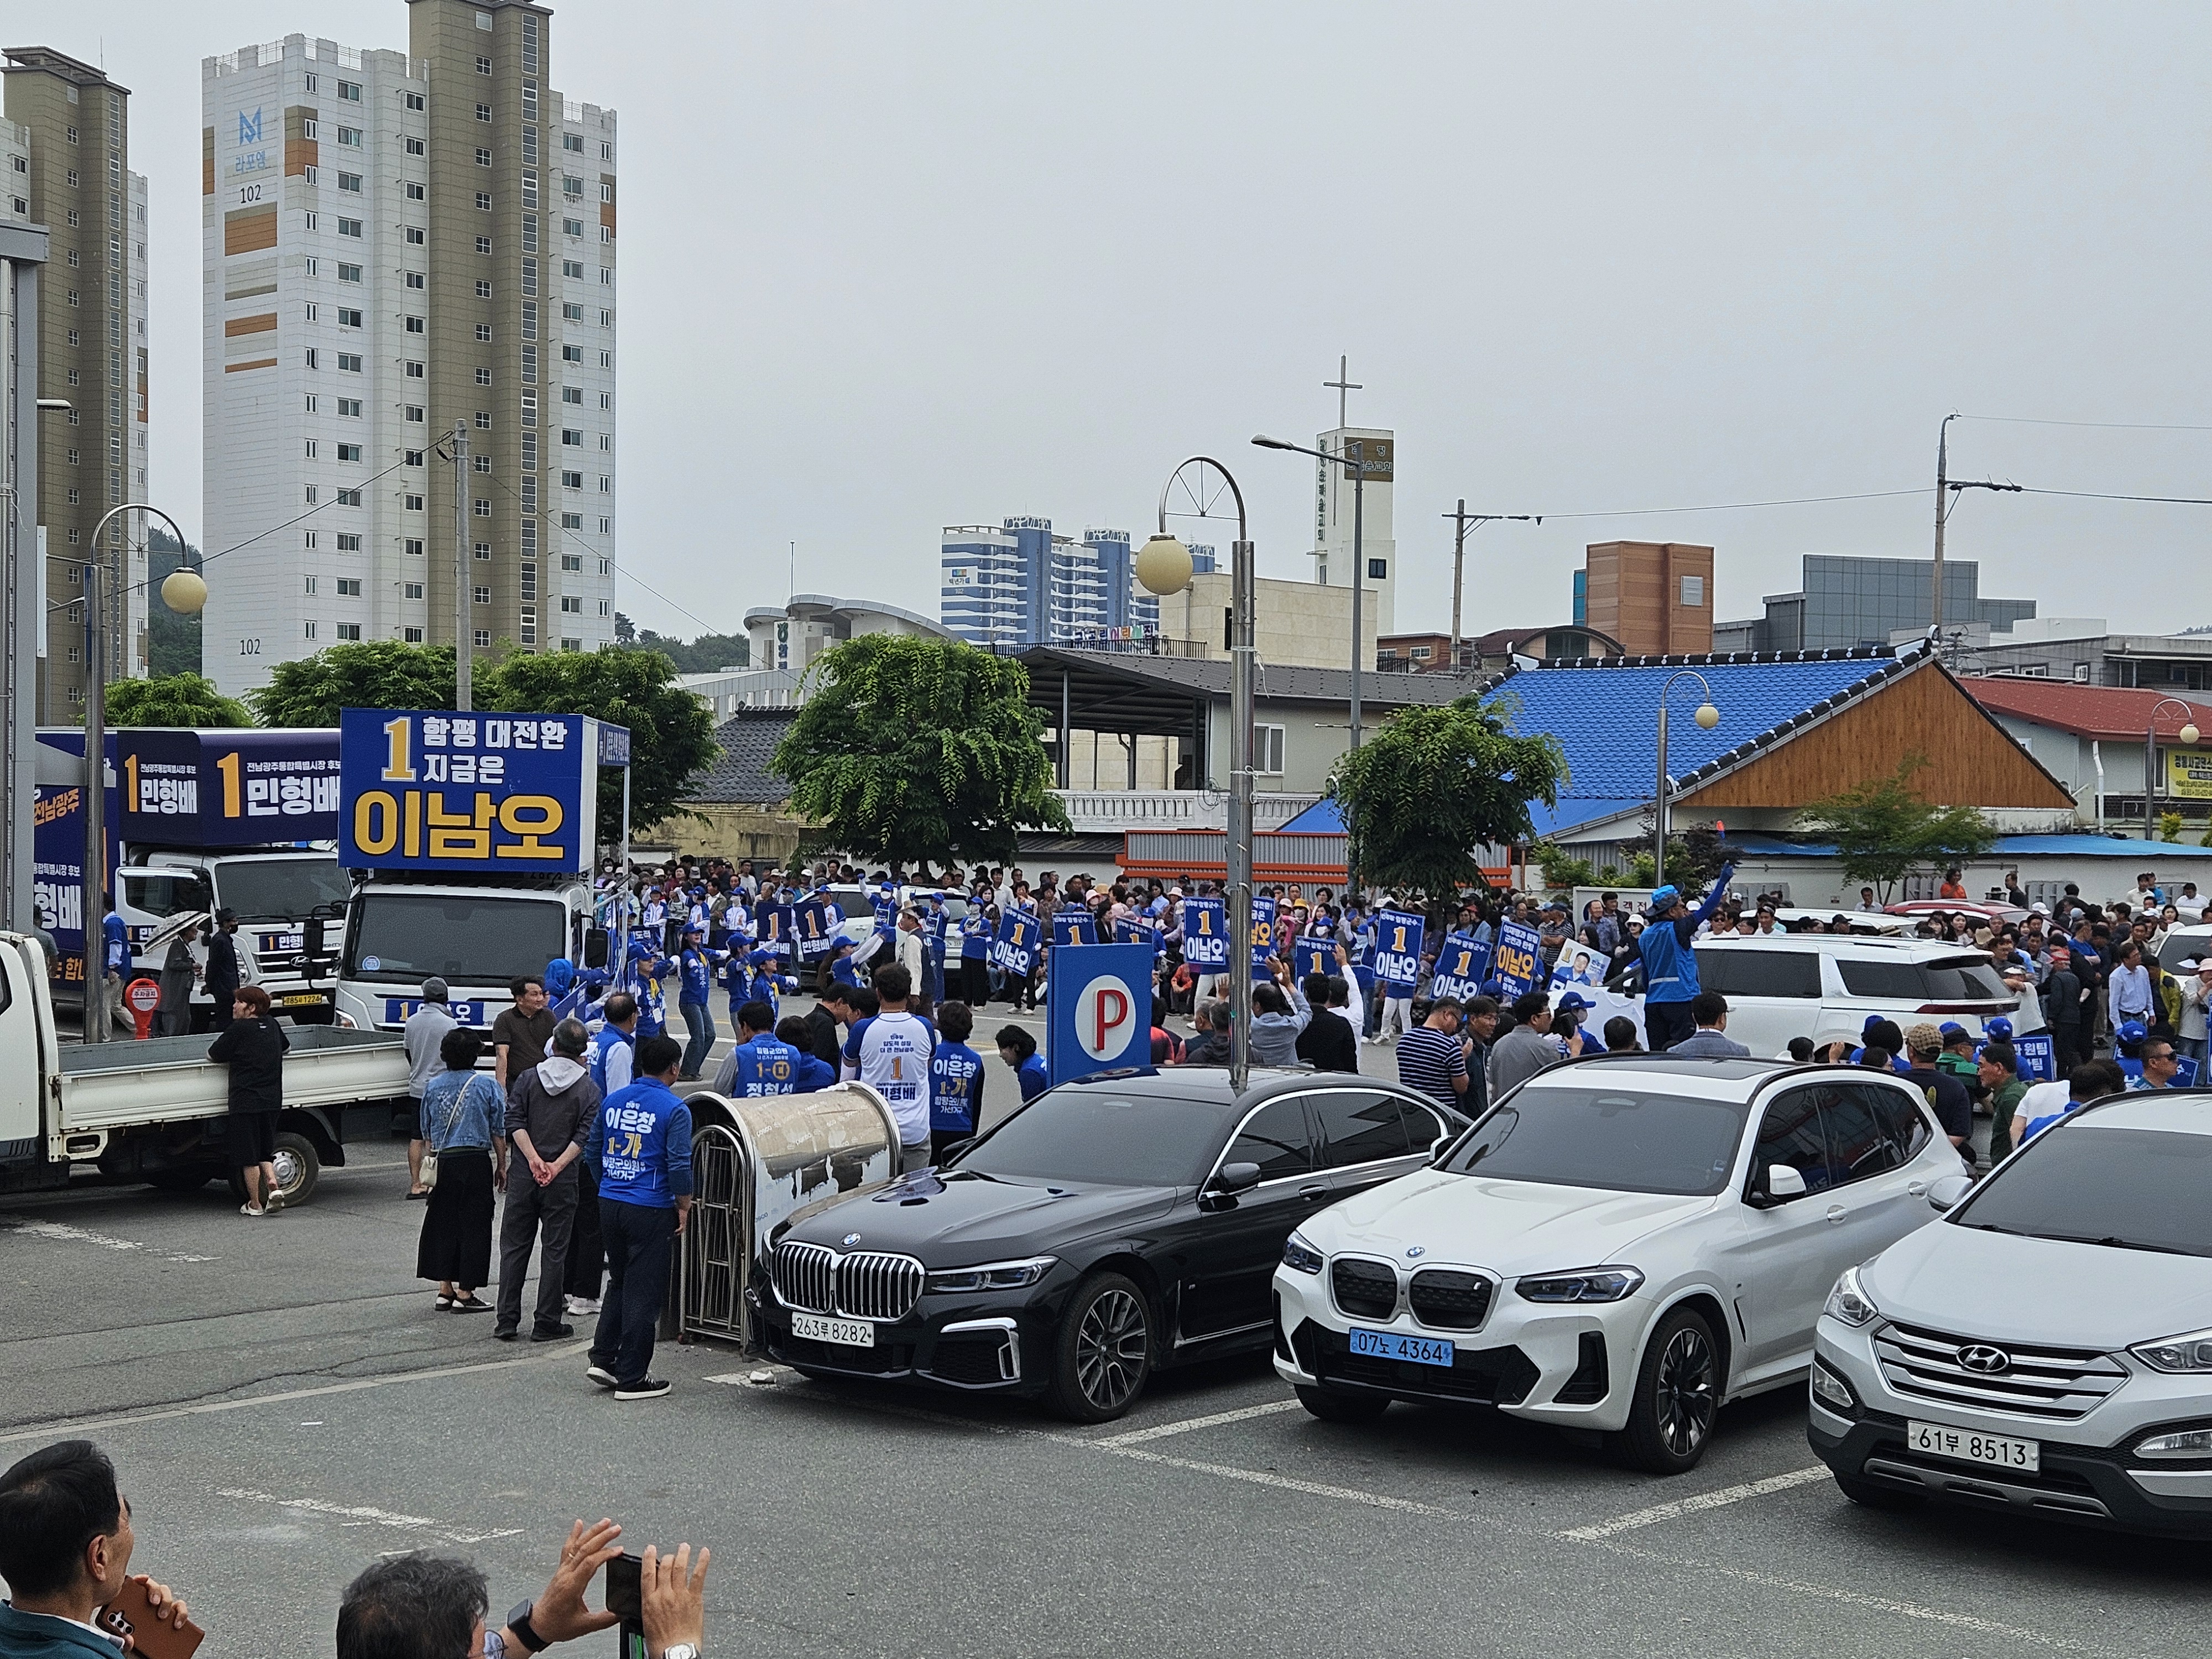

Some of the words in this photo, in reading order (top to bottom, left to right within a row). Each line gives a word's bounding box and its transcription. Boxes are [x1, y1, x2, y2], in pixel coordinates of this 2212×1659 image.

[241, 184, 261, 204] 102
[1346, 460, 1392, 472] 음교회
[240, 639, 260, 655] 102
[423, 717, 477, 747] 함평
[485, 719, 568, 750] 대전환
[382, 716, 416, 782] 1
[186, 765, 196, 774] 후보
[247, 760, 326, 772] 전남광주통합특별시장
[423, 754, 505, 784] 지금은
[124, 754, 138, 812] 1
[217, 752, 240, 818] 1
[34, 787, 80, 827] 전남광주
[140, 778, 197, 814] 민형배
[247, 776, 341, 816] 민형배
[354, 790, 565, 859] 이남오
[67, 865, 81, 877] 후보
[635, 930, 651, 940] 도적
[768, 912, 779, 940] 1
[805, 909, 820, 938] 1
[1010, 923, 1025, 946] 1
[1068, 925, 1083, 946] 1
[1198, 911, 1212, 935] 1
[268, 936, 274, 950] 1
[279, 935, 304, 949] 민형
[802, 938, 831, 954] 민형배
[1187, 937, 1224, 962] 이남오
[1391, 926, 1406, 953] 1
[994, 940, 1029, 973] 이남오
[1310, 951, 1324, 974] 1
[1376, 951, 1417, 982] 이남오
[1453, 951, 1472, 977] 1
[1498, 945, 1533, 980] 이남오
[1562, 947, 1573, 963] 1
[1433, 974, 1478, 1004] 이남오
[1496, 973, 1503, 984] 1
[304, 994, 320, 1003] 1224
[399, 1001, 409, 1021] 1
[1096, 989, 1129, 1051] P
[2024, 1042, 2048, 1056] 원팀
[890, 1056, 903, 1081] 1
[933, 1058, 977, 1078] 이은창
[939, 1077, 967, 1097] 1-가
[606, 1108, 656, 1134] 이은창
[607, 1132, 642, 1159] 1-가
[796, 1317, 829, 1337] 263루
[832, 1322, 868, 1343] 8282
[1358, 1333, 1390, 1354] 07노
[1398, 1339, 1443, 1362] 4364
[1919, 1428, 1959, 1452] 61부
[1970, 1437, 2026, 1465] 8513
